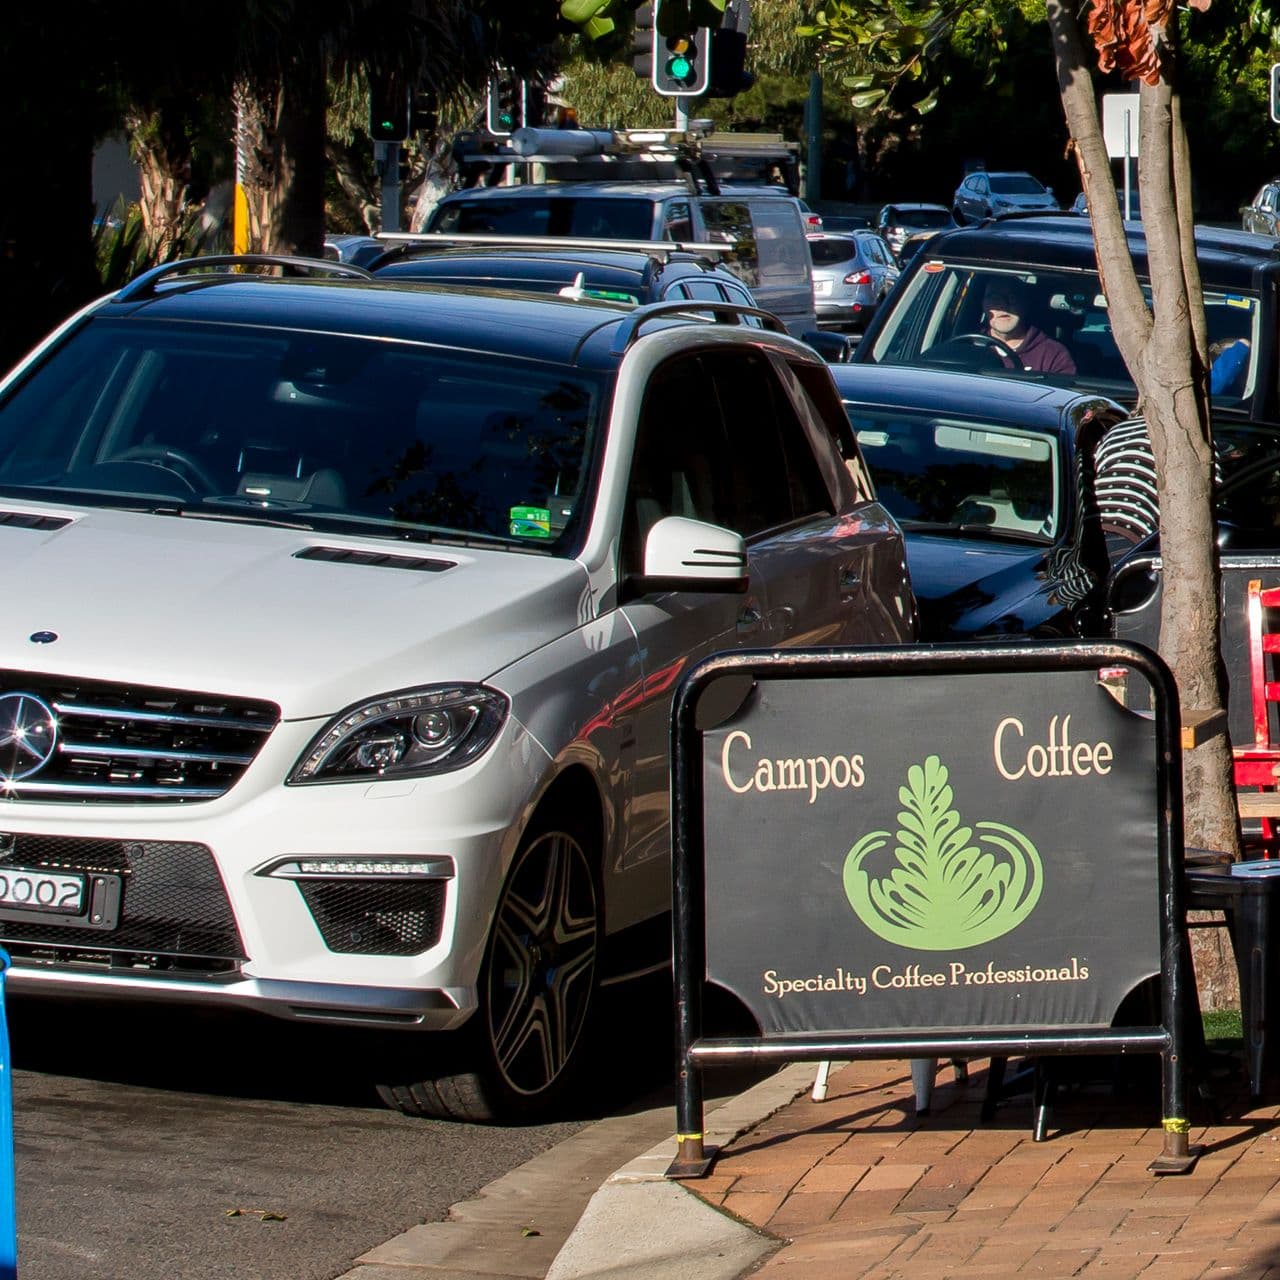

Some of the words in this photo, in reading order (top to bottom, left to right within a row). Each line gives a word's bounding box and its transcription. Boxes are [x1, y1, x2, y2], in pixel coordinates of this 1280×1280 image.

[721, 730, 865, 803] Campos
[993, 714, 1113, 781] Coffee
[763, 967, 867, 999] Specialty
[871, 963, 946, 990] Coffee
[949, 958, 1090, 988] Professionals
